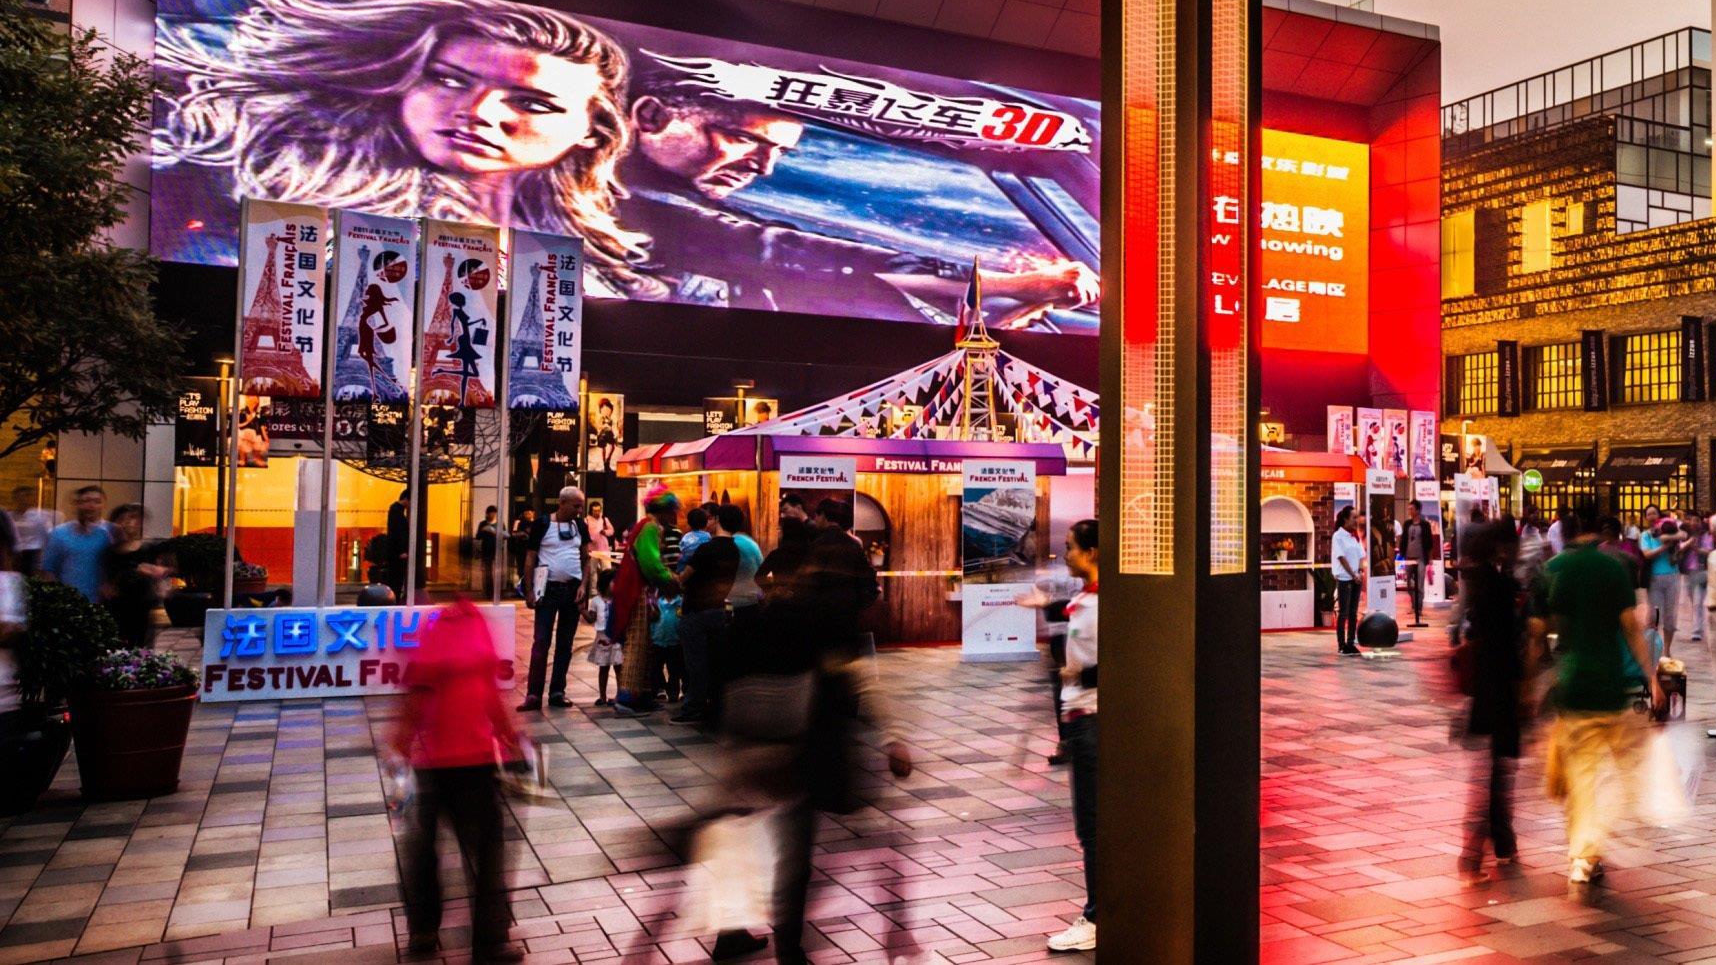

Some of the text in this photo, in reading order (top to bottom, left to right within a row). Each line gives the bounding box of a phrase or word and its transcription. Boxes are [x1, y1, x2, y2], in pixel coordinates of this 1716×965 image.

[296, 225, 318, 353] 法国文化节
[279, 292, 294, 352] FESTIVAL
[557, 255, 577, 373] 法国文化节
[541, 316, 556, 372] FESTIVAL
[787, 472, 848, 483] FRENCH FESTIVAL
[875, 457, 963, 472] FESTIVAL FRAN
[998, 472, 1029, 483] FESTIVAL
[220, 611, 440, 659] 法国文化
[204, 663, 352, 693] FESTIVAL
